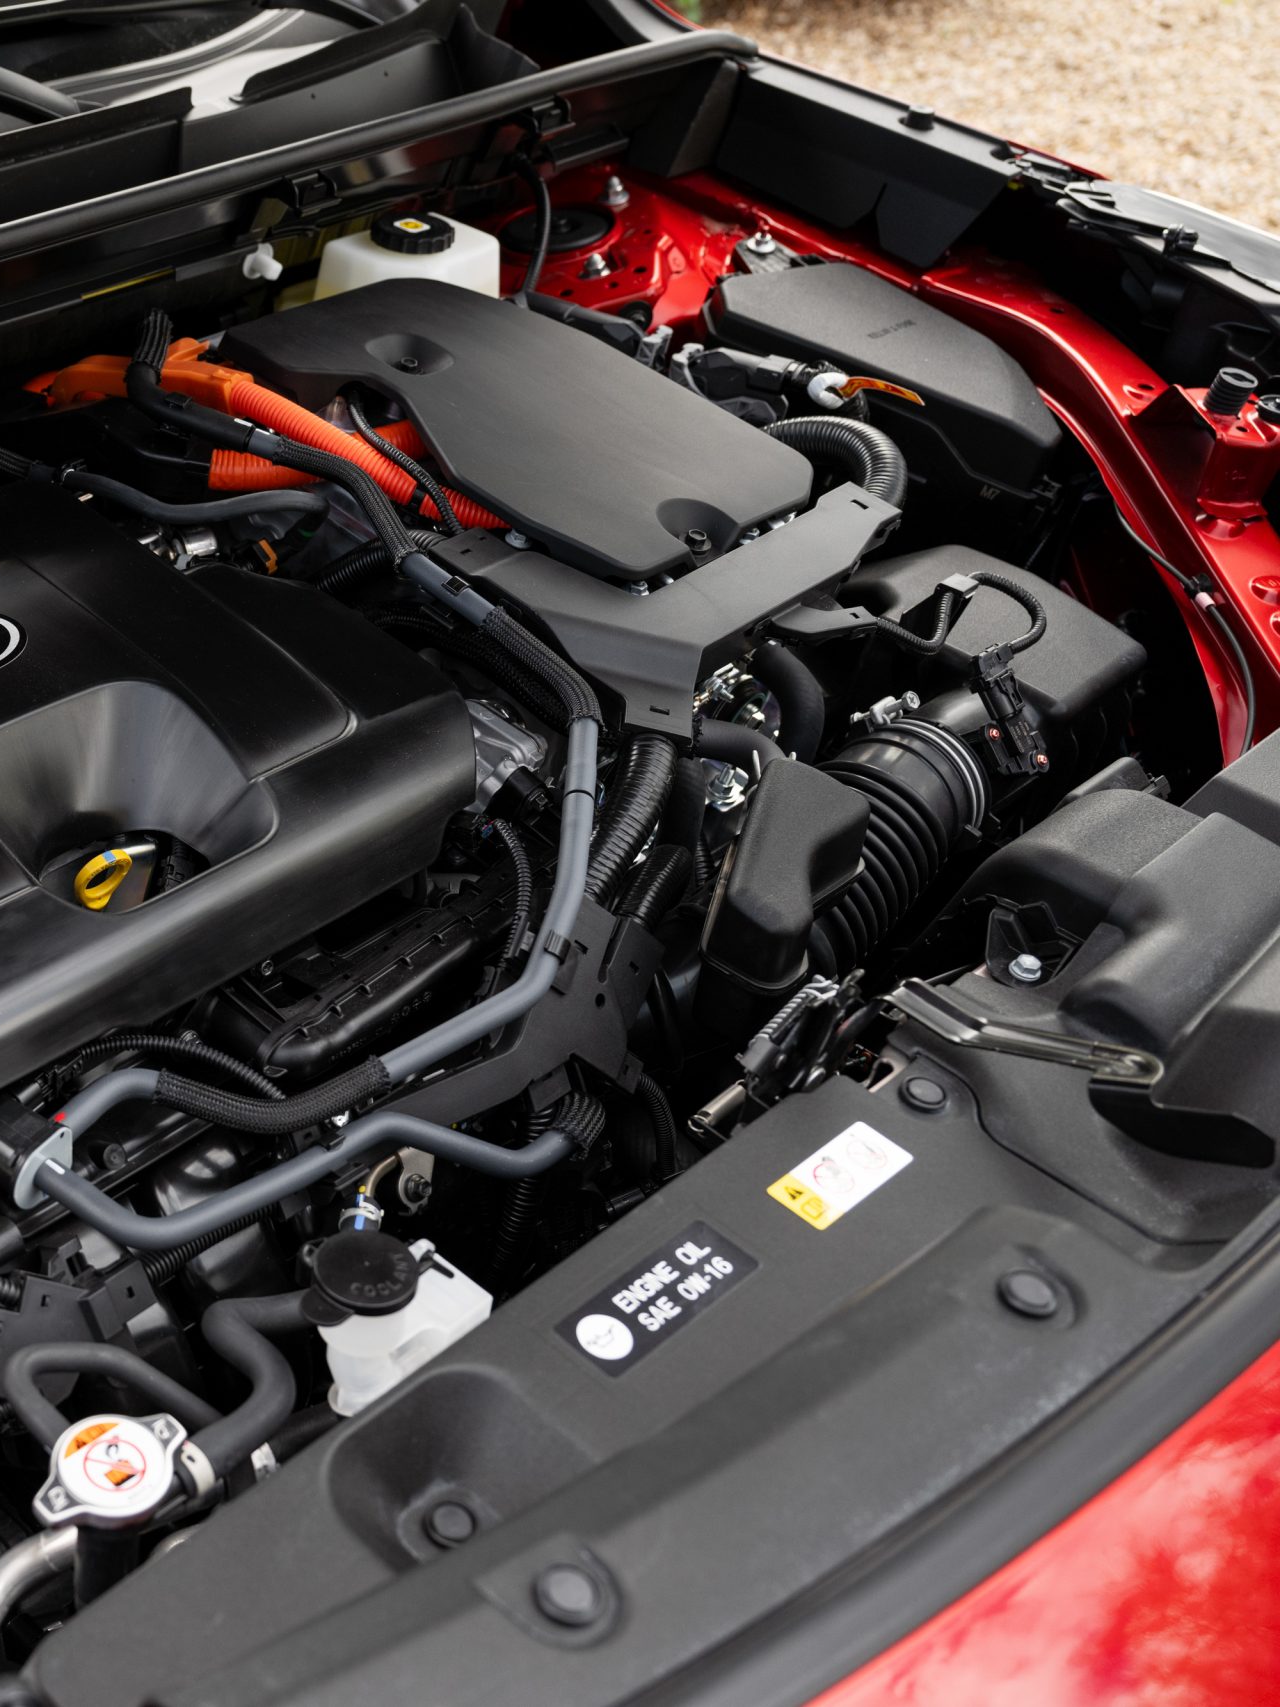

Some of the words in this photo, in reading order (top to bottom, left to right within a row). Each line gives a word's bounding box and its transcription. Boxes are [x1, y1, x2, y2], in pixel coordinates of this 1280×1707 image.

[611, 1260, 680, 1315] ENGINE
[674, 1240, 712, 1266] OIL
[637, 1295, 683, 1333] SAE
